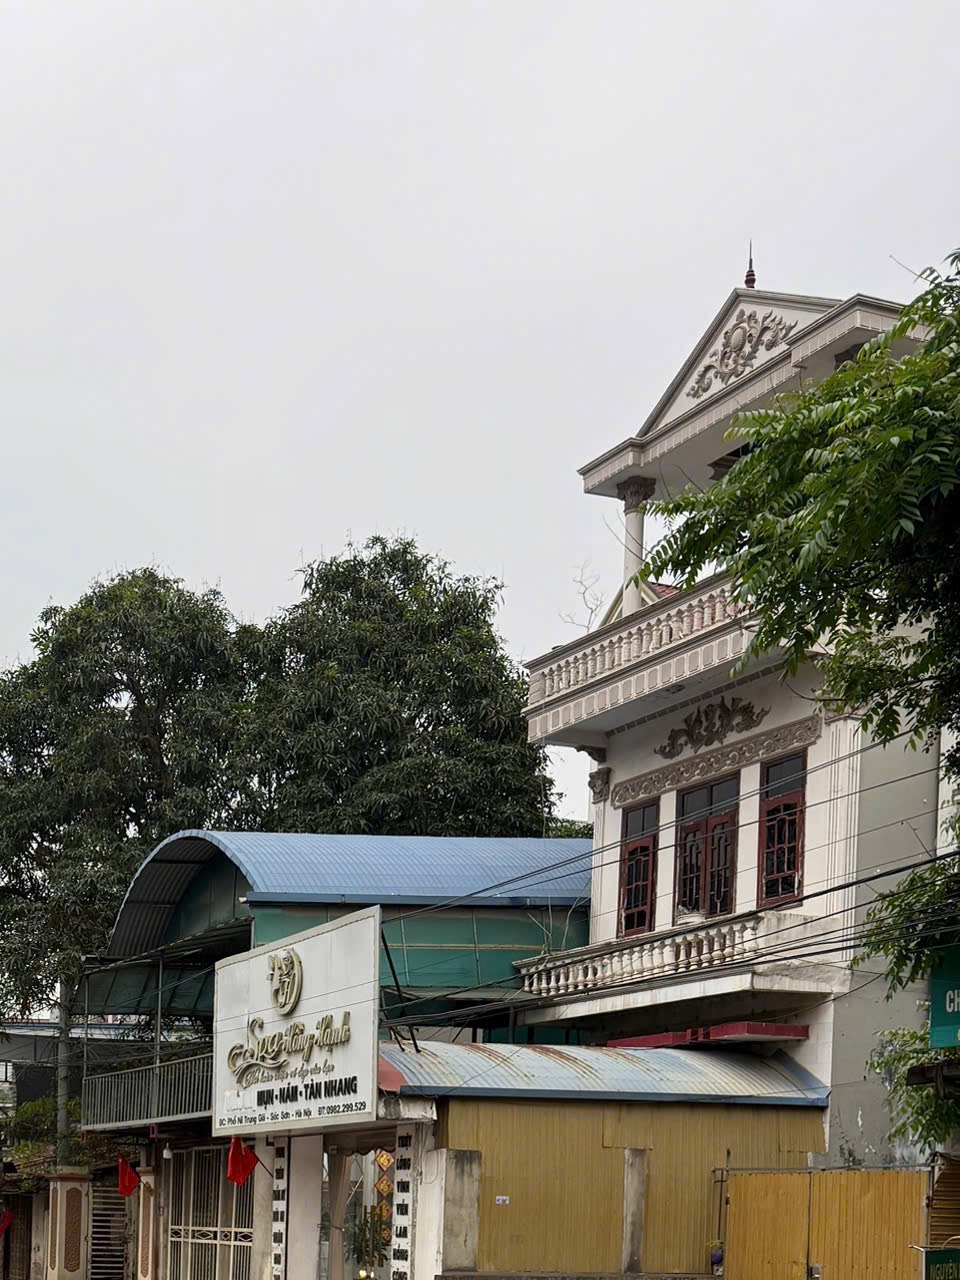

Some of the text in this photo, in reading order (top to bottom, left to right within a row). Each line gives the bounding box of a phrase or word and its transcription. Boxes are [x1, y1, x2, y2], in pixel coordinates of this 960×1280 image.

[257, 1088, 275, 1110] MỤN
[303, 1078, 322, 1101] TÀN
[324, 1076, 358, 1099] NHANG
